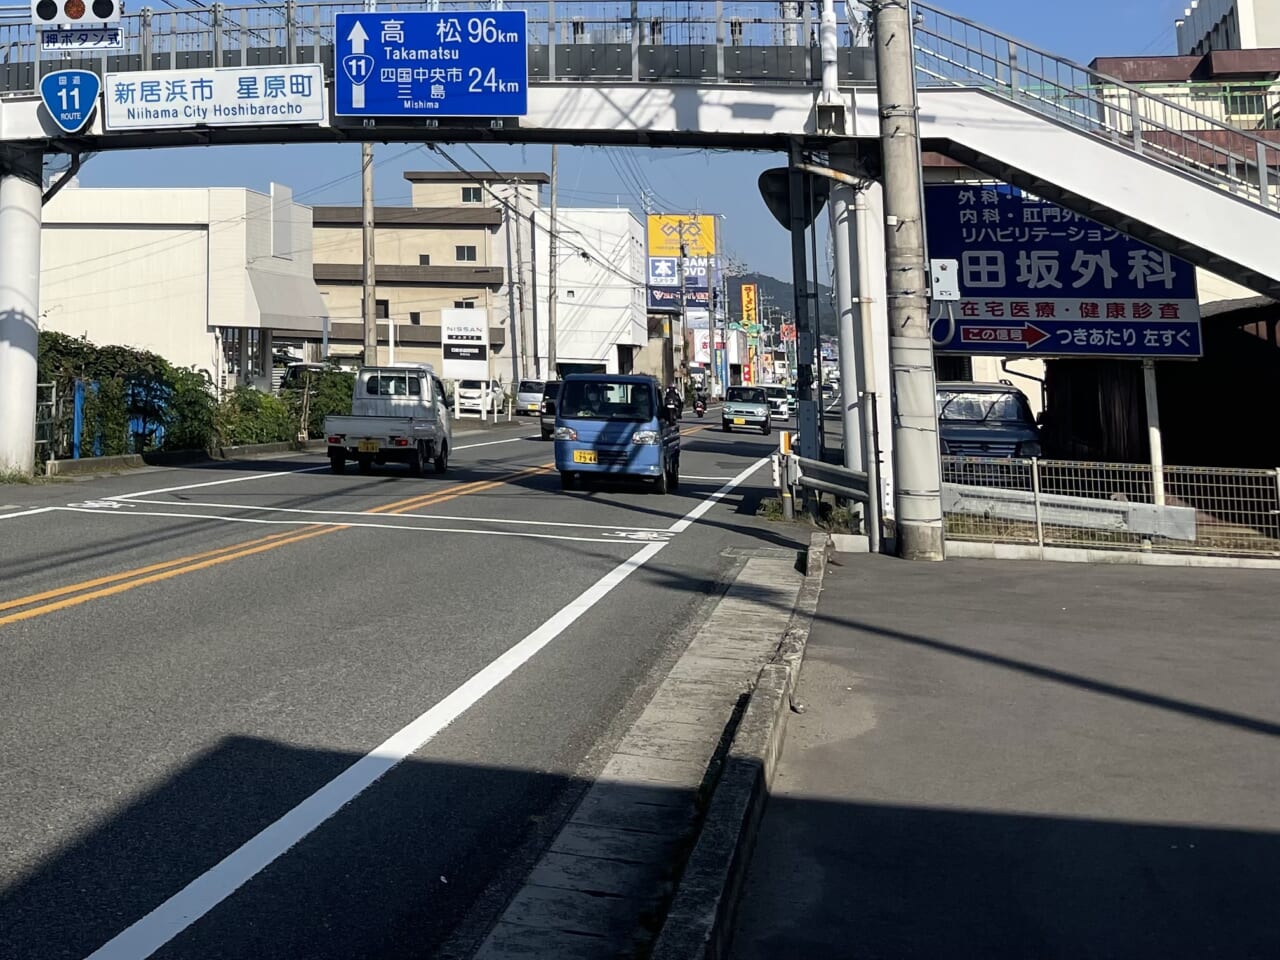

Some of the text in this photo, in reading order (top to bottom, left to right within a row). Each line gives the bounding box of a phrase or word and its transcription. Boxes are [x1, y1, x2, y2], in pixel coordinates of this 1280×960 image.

[46, 32, 121, 48] 押ボタン式
[384, 46, 459, 61] Takamatsu
[348, 58, 367, 77] 11
[380, 67, 463, 84] 四国中央市
[58, 75, 81, 86] 国道
[114, 74, 313, 105] 新居浜市 星原町
[57, 87, 81, 110] 11
[403, 100, 440, 110] Mishima
[60, 111, 82, 121] ROUTE
[127, 102, 303, 121] Niihama City Hoshibaracho
[962, 249, 1177, 290] 田坂外科
[960, 301, 1181, 319] 在宅医療・健康診査
[968, 328, 1023, 341] この信号
[1056, 328, 1191, 347] つきあたり 左すぐ
